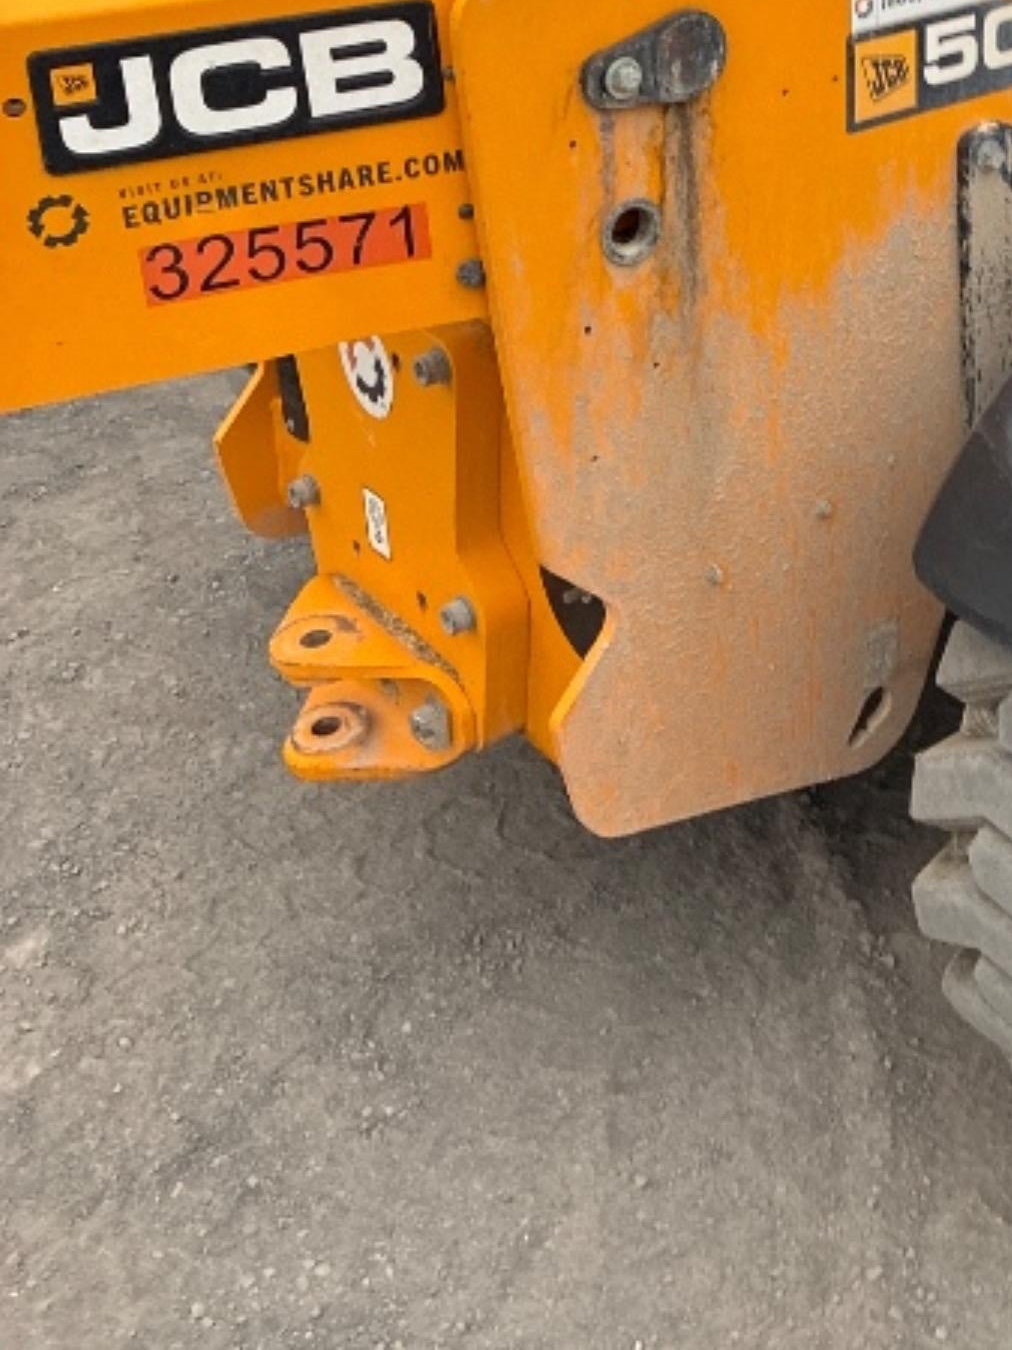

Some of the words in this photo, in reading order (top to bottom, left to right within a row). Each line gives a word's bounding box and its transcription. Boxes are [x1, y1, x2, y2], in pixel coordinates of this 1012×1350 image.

[59, 19, 425, 155] JCB
[121, 150, 465, 229] EQUIPMENTSHARE.COM
[146, 204, 416, 301] 325571
